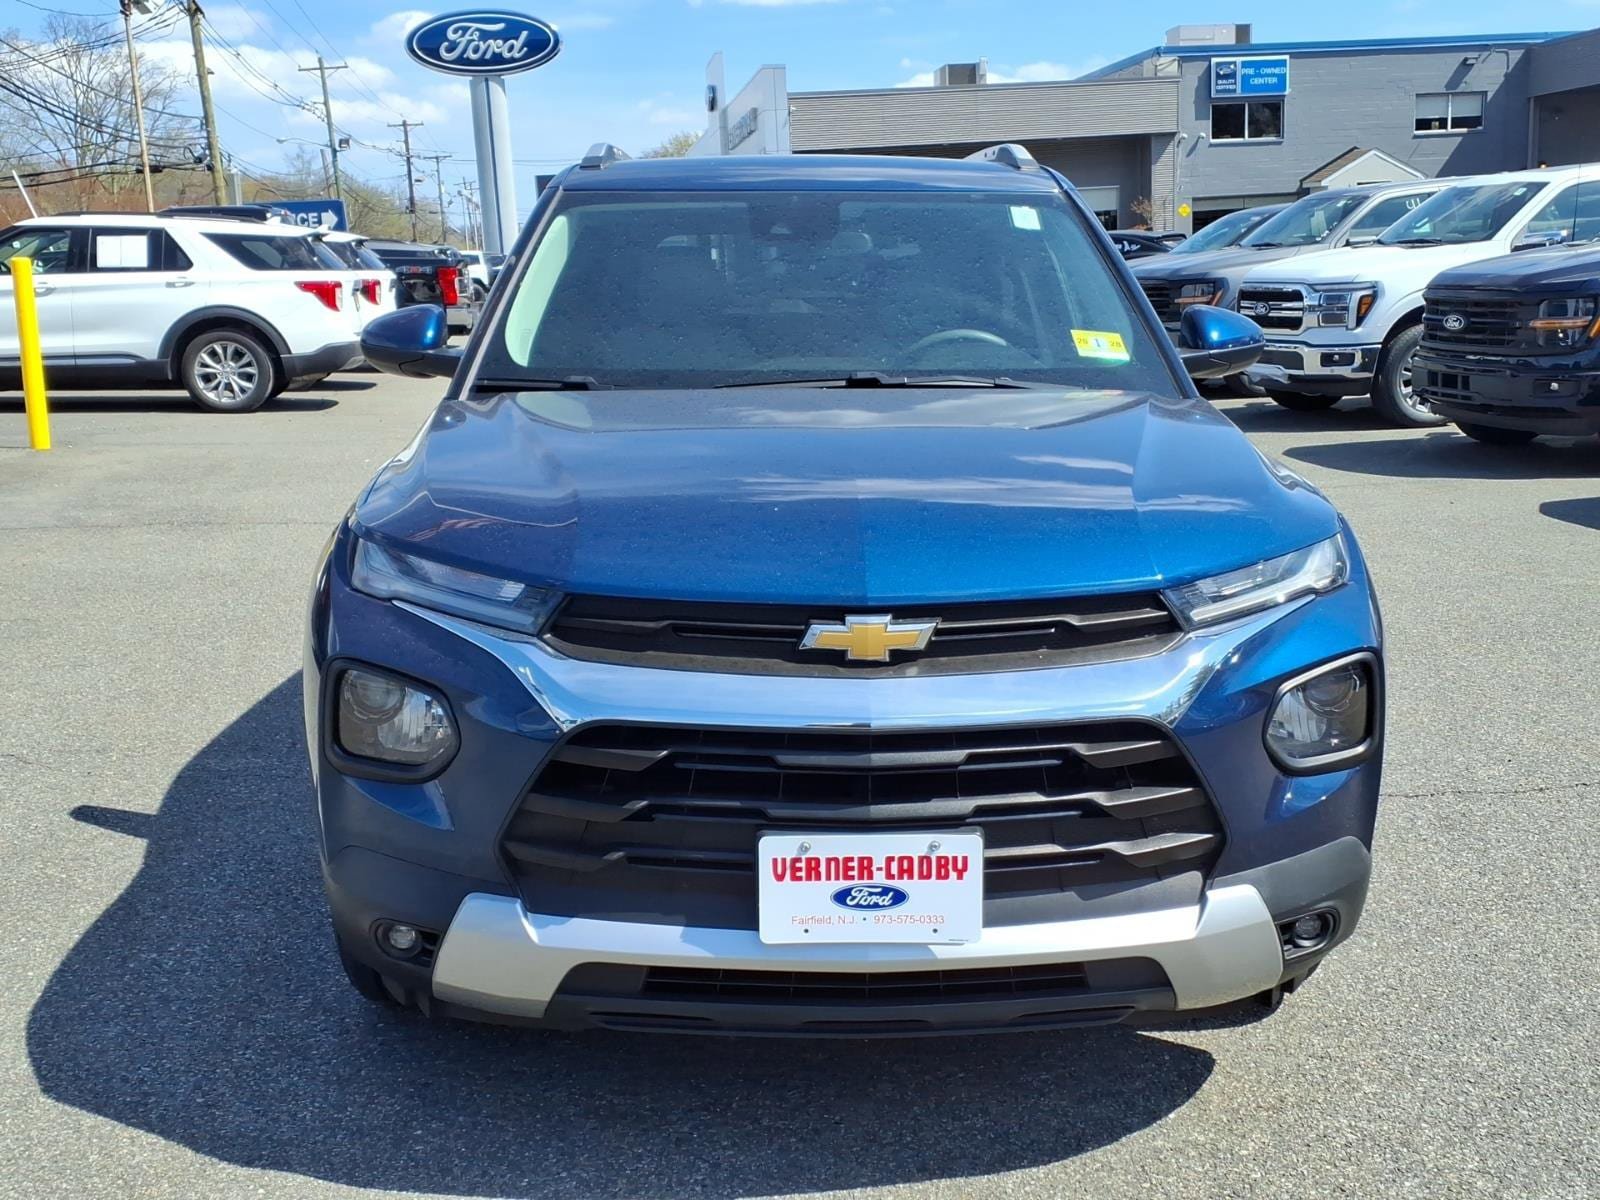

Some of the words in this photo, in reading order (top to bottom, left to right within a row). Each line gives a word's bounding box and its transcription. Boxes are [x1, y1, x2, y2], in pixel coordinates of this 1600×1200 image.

[439, 22, 529, 61] Ford
[1241, 67, 1255, 75] PRE
[1260, 66, 1286, 75] OWNED
[1249, 77, 1278, 85] CENTER
[772, 855, 968, 882] VERNER-CADBY
[846, 887, 894, 906] Ford
[791, 915, 834, 926] Fairfield,
[838, 915, 858, 925] N.J.
[874, 915, 945, 925] 973-575-0333
